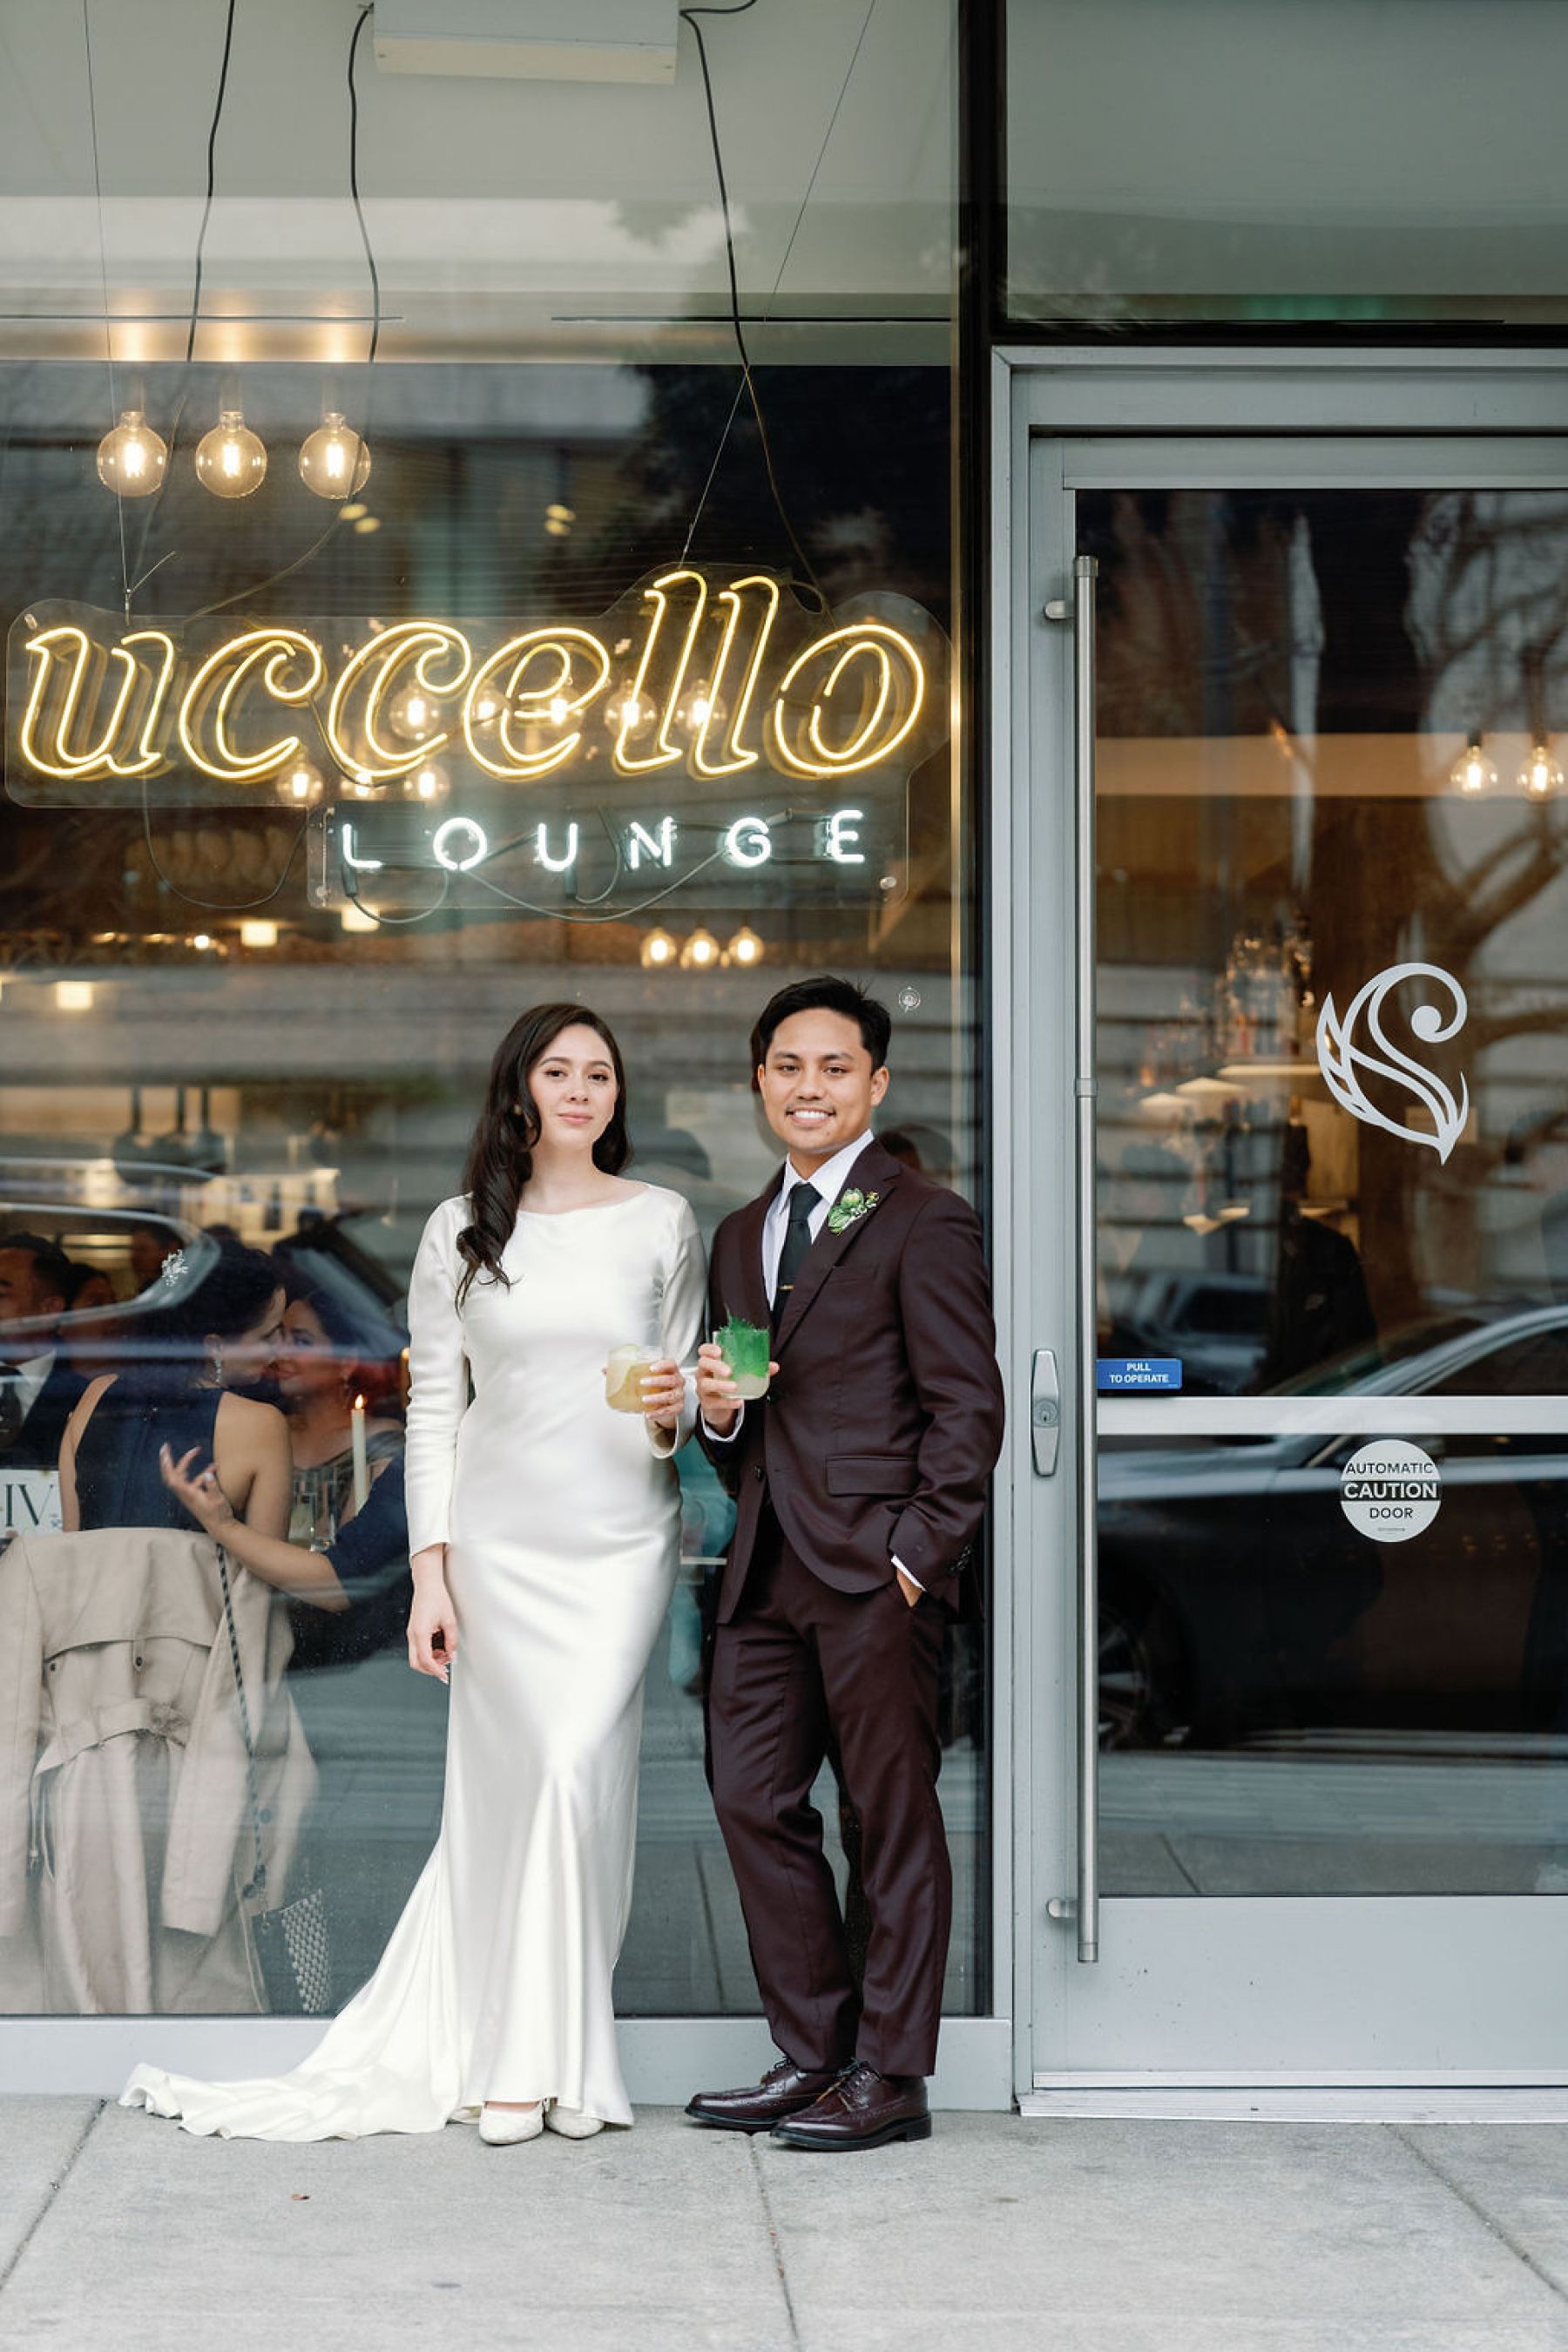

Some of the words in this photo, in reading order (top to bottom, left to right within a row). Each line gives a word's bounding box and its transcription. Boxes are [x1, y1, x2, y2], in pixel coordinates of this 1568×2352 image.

[18, 571, 927, 778] uccello
[341, 809, 867, 872] LOUNGE
[1126, 1362, 1152, 1371] PULL
[1110, 1375, 1123, 1383] TO
[1125, 1375, 1169, 1383] OPERATE
[1345, 1462, 1433, 1474] AUTOMATIC
[1343, 1482, 1437, 1498] CAUTION
[1369, 1507, 1414, 1518] DOOR
